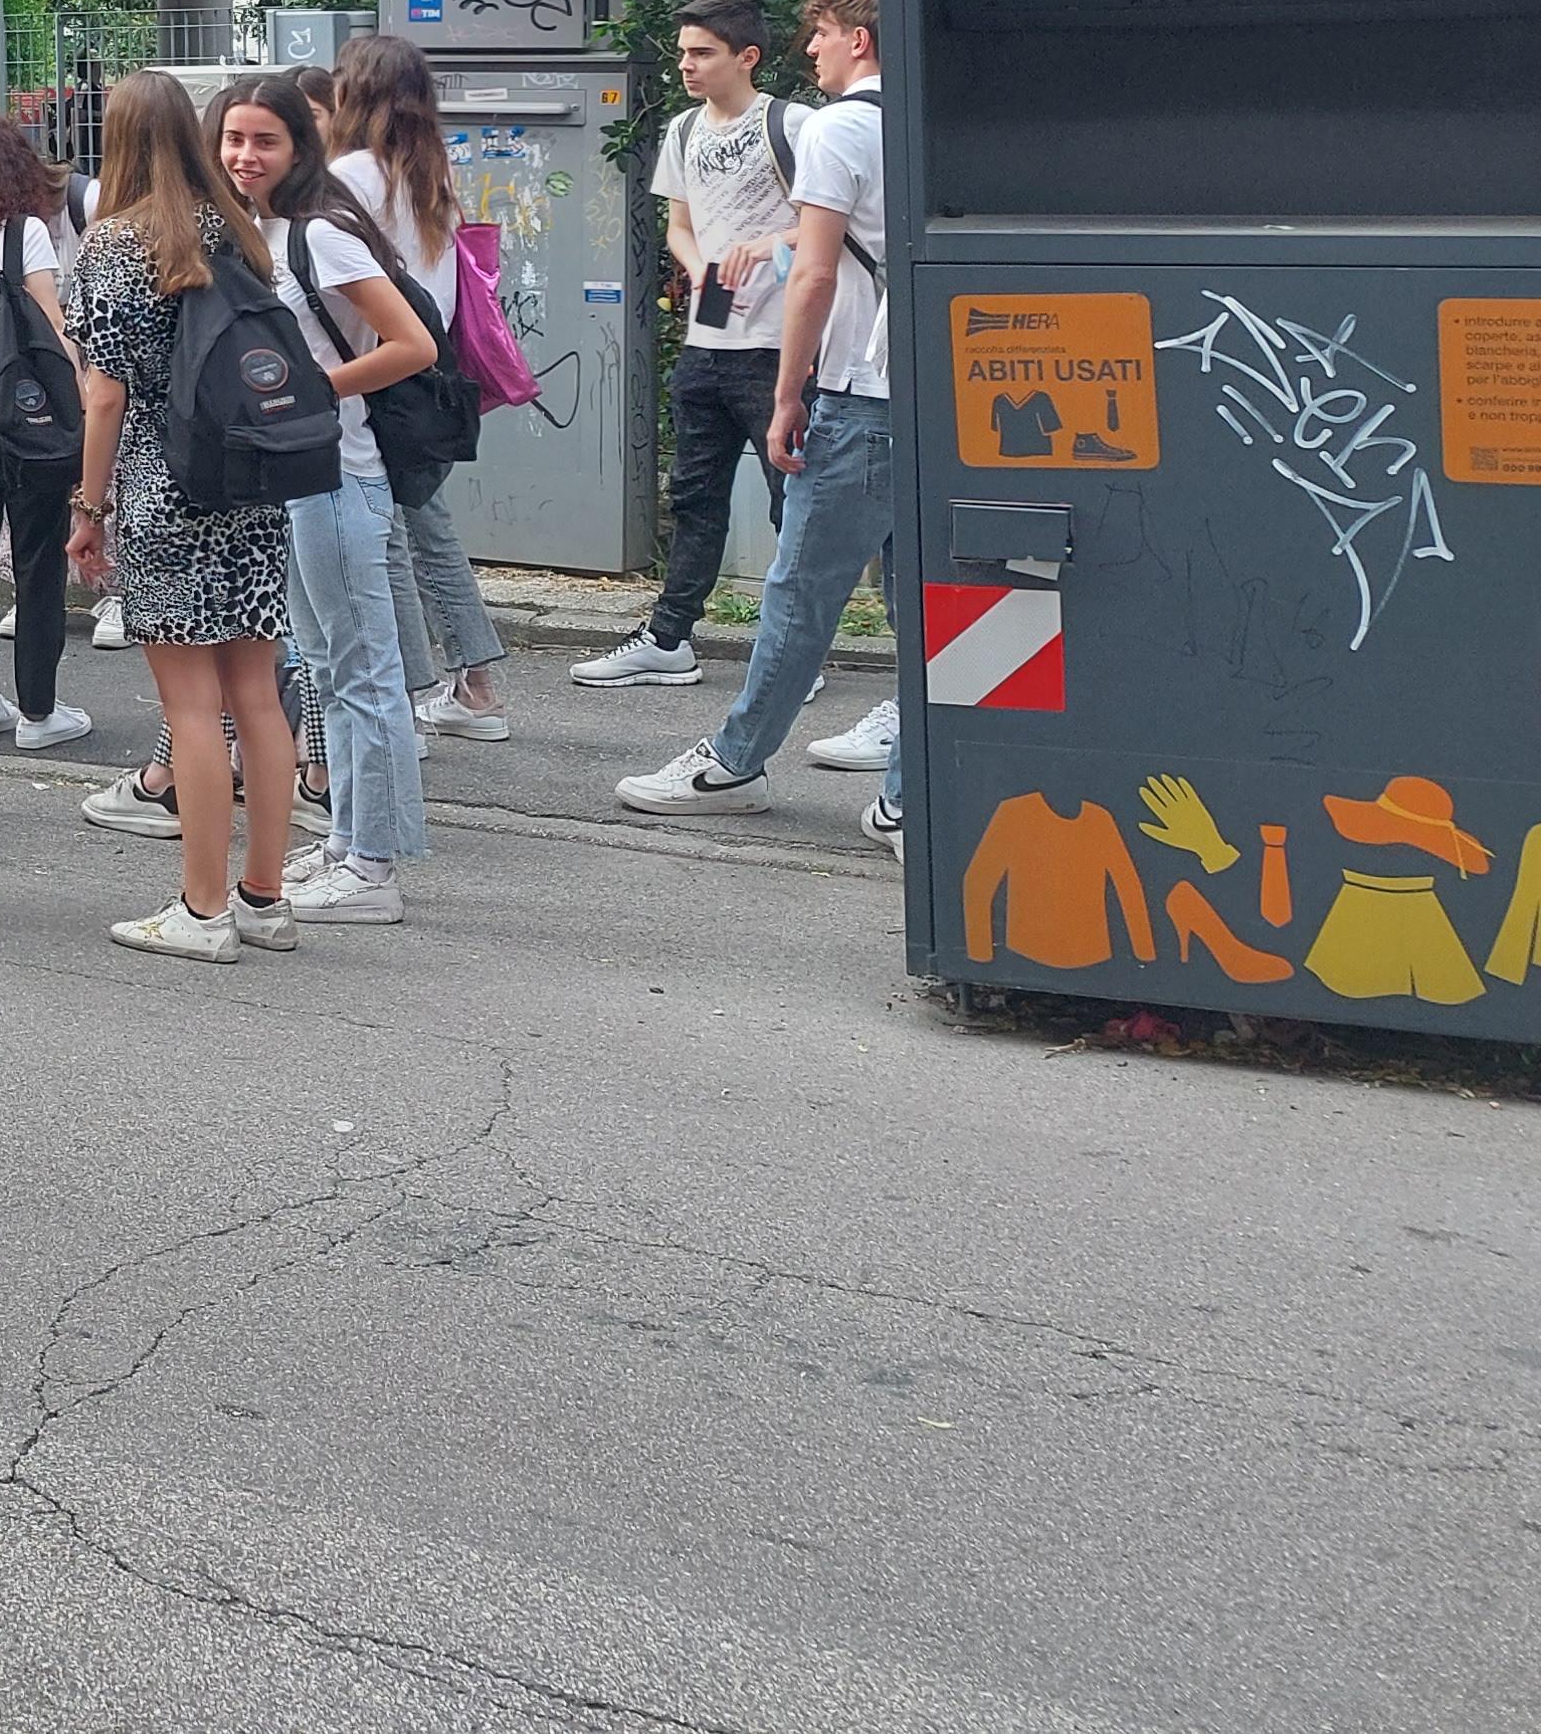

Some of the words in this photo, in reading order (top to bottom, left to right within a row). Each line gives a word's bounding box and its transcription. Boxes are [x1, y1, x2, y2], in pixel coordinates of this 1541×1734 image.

[422, 9, 440, 18] TIM
[1011, 312, 1061, 330] HERA
[1464, 315, 1532, 327] introdurre
[968, 358, 1045, 382] ABITI
[1053, 358, 1143, 382] USATI
[1480, 412, 1506, 422] non
